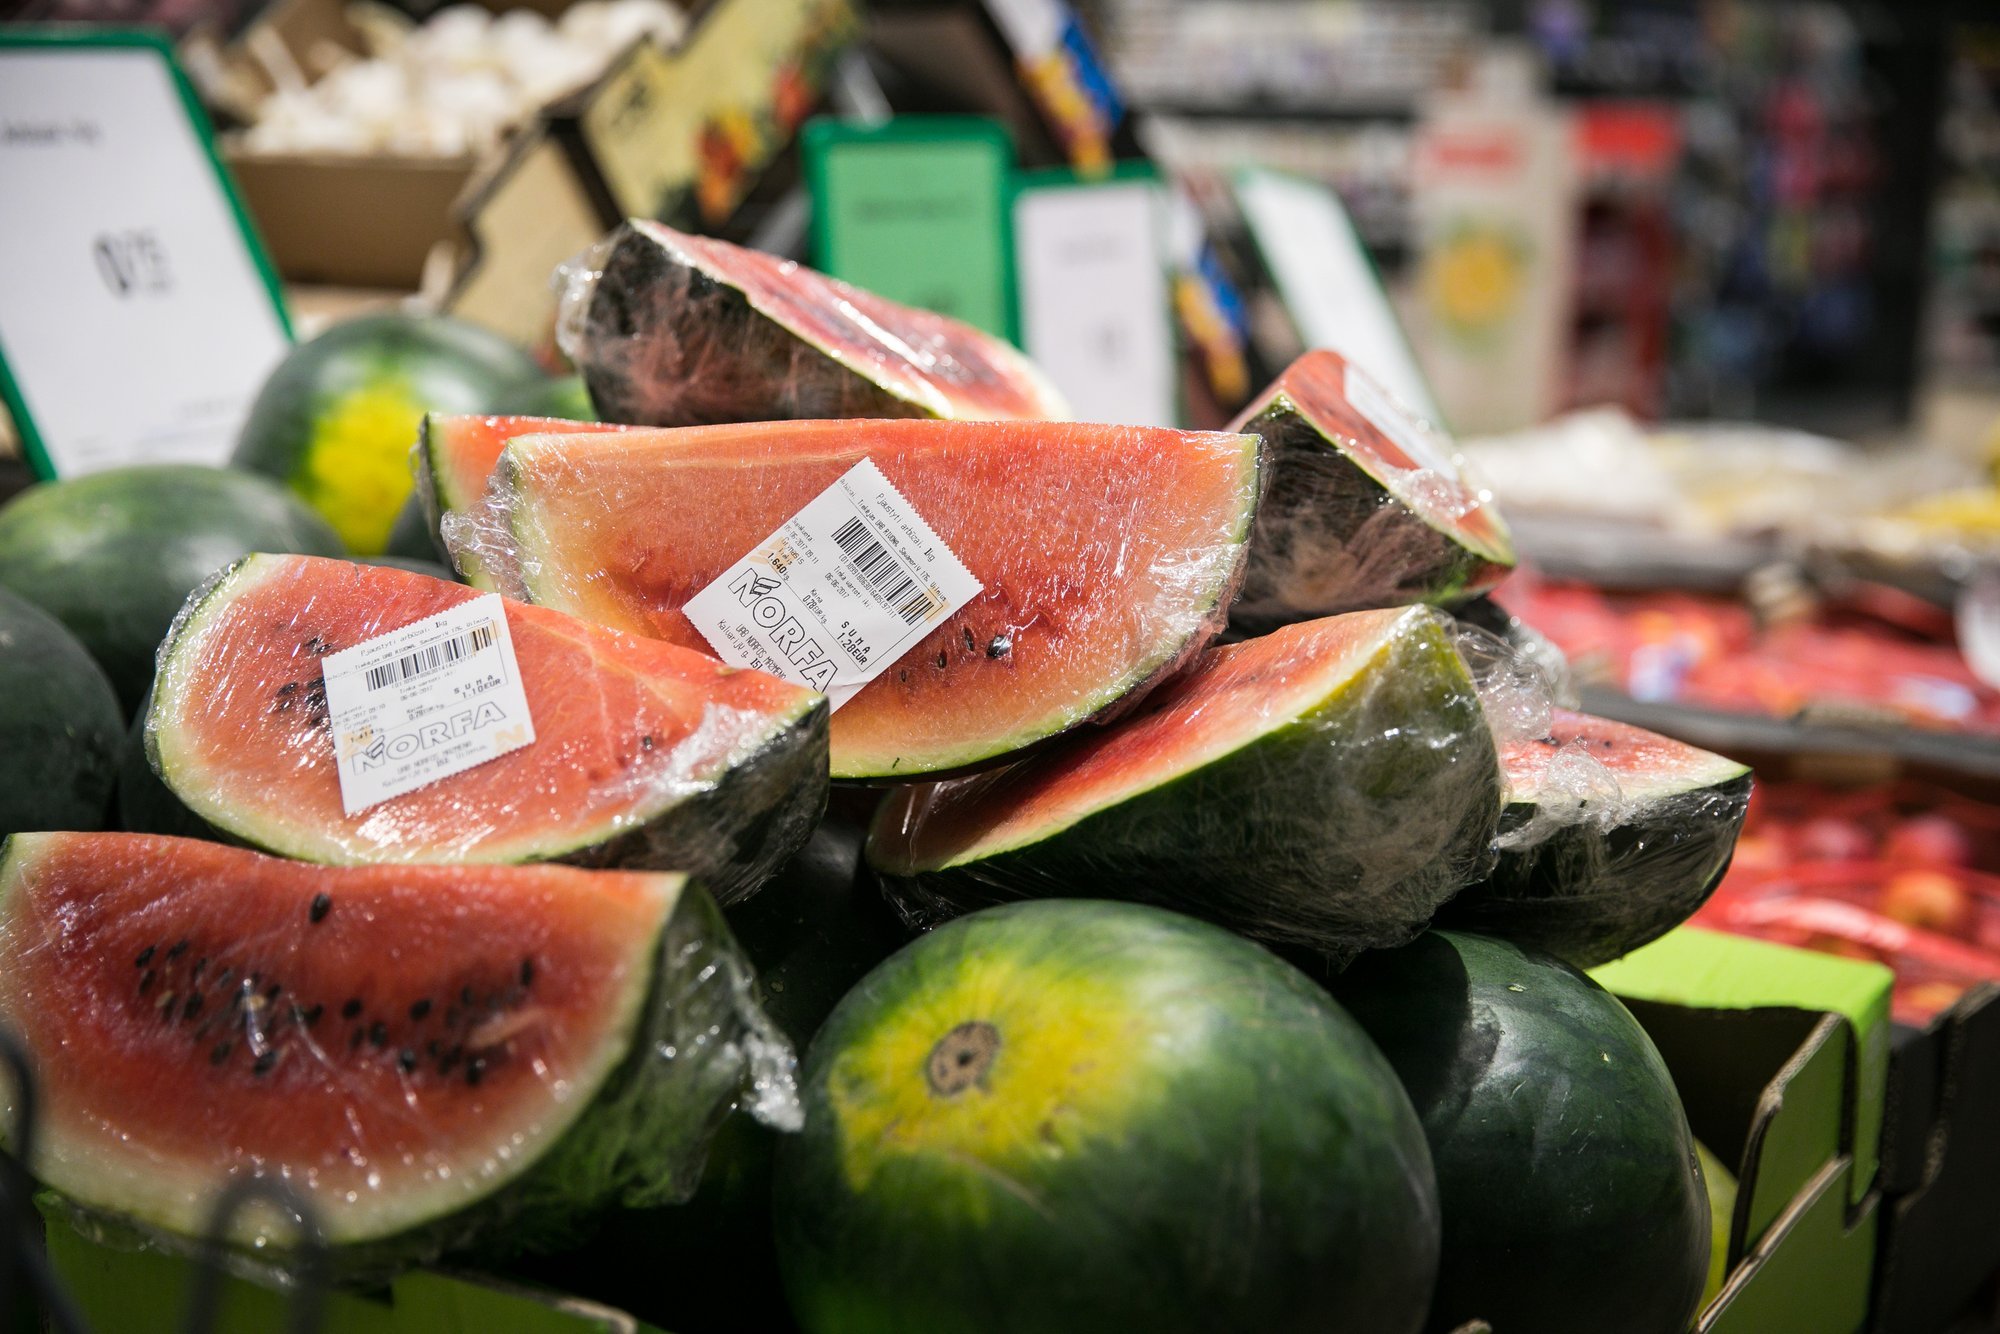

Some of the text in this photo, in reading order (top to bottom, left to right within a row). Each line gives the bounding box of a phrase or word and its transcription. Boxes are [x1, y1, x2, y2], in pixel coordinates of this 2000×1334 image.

[873, 492, 904, 524] Pjaustyti
[922, 547, 937, 562] 1kg
[804, 549, 819, 564] 09:11
[874, 519, 885, 530] UAB
[928, 581, 948, 601] Vilnius
[809, 588, 824, 604] Kaina
[823, 572, 849, 600] 06-06-2017
[833, 565, 848, 581] Tinka
[844, 578, 863, 598] vartoti
[727, 567, 837, 695] NORFA
[735, 623, 750, 638] UAB
[745, 635, 766, 658] NORFOS
[740, 649, 750, 659] g.
[352, 701, 506, 776] NORFA
